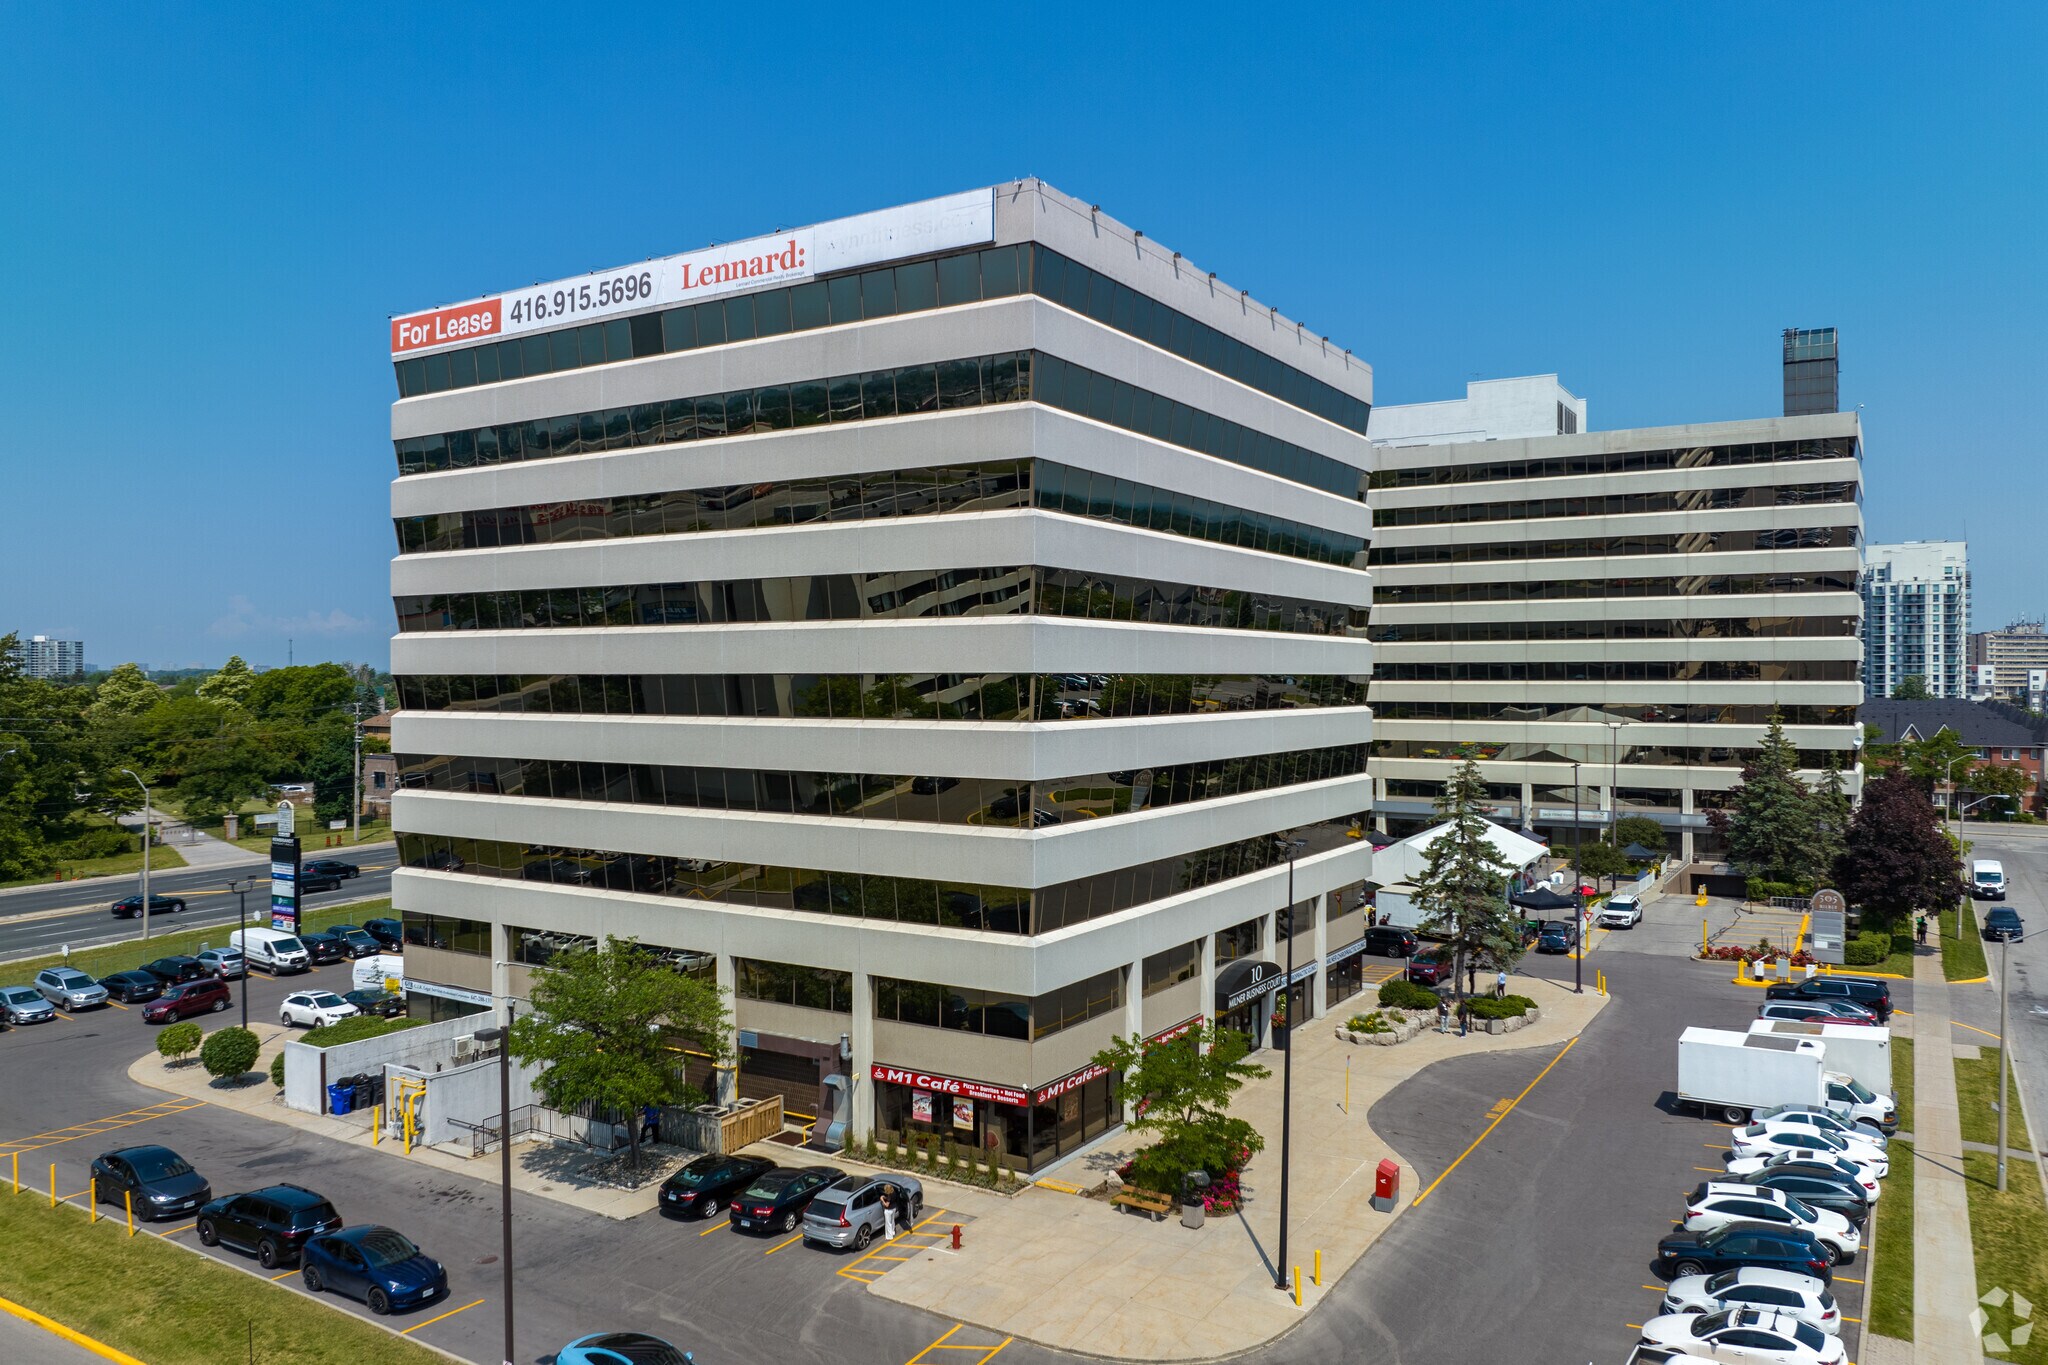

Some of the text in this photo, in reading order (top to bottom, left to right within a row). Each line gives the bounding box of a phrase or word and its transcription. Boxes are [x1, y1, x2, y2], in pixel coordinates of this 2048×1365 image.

[681, 239, 805, 290] Lennard:
[510, 272, 652, 324] 416.915.5696
[399, 311, 493, 347] For Lease
[1251, 965, 1262, 984] 10
[1228, 993, 1246, 1009] MILNER
[1246, 982, 1267, 1000] BUSINESS
[1267, 976, 1281, 990] COURT
[887, 1069, 960, 1093] M1 Café
[963, 1082, 1026, 1099] Pizza Burritos Hot Food
[969, 1089, 1019, 1104] Breakfast Desserts
[1047, 1068, 1093, 1099] M1 Café
